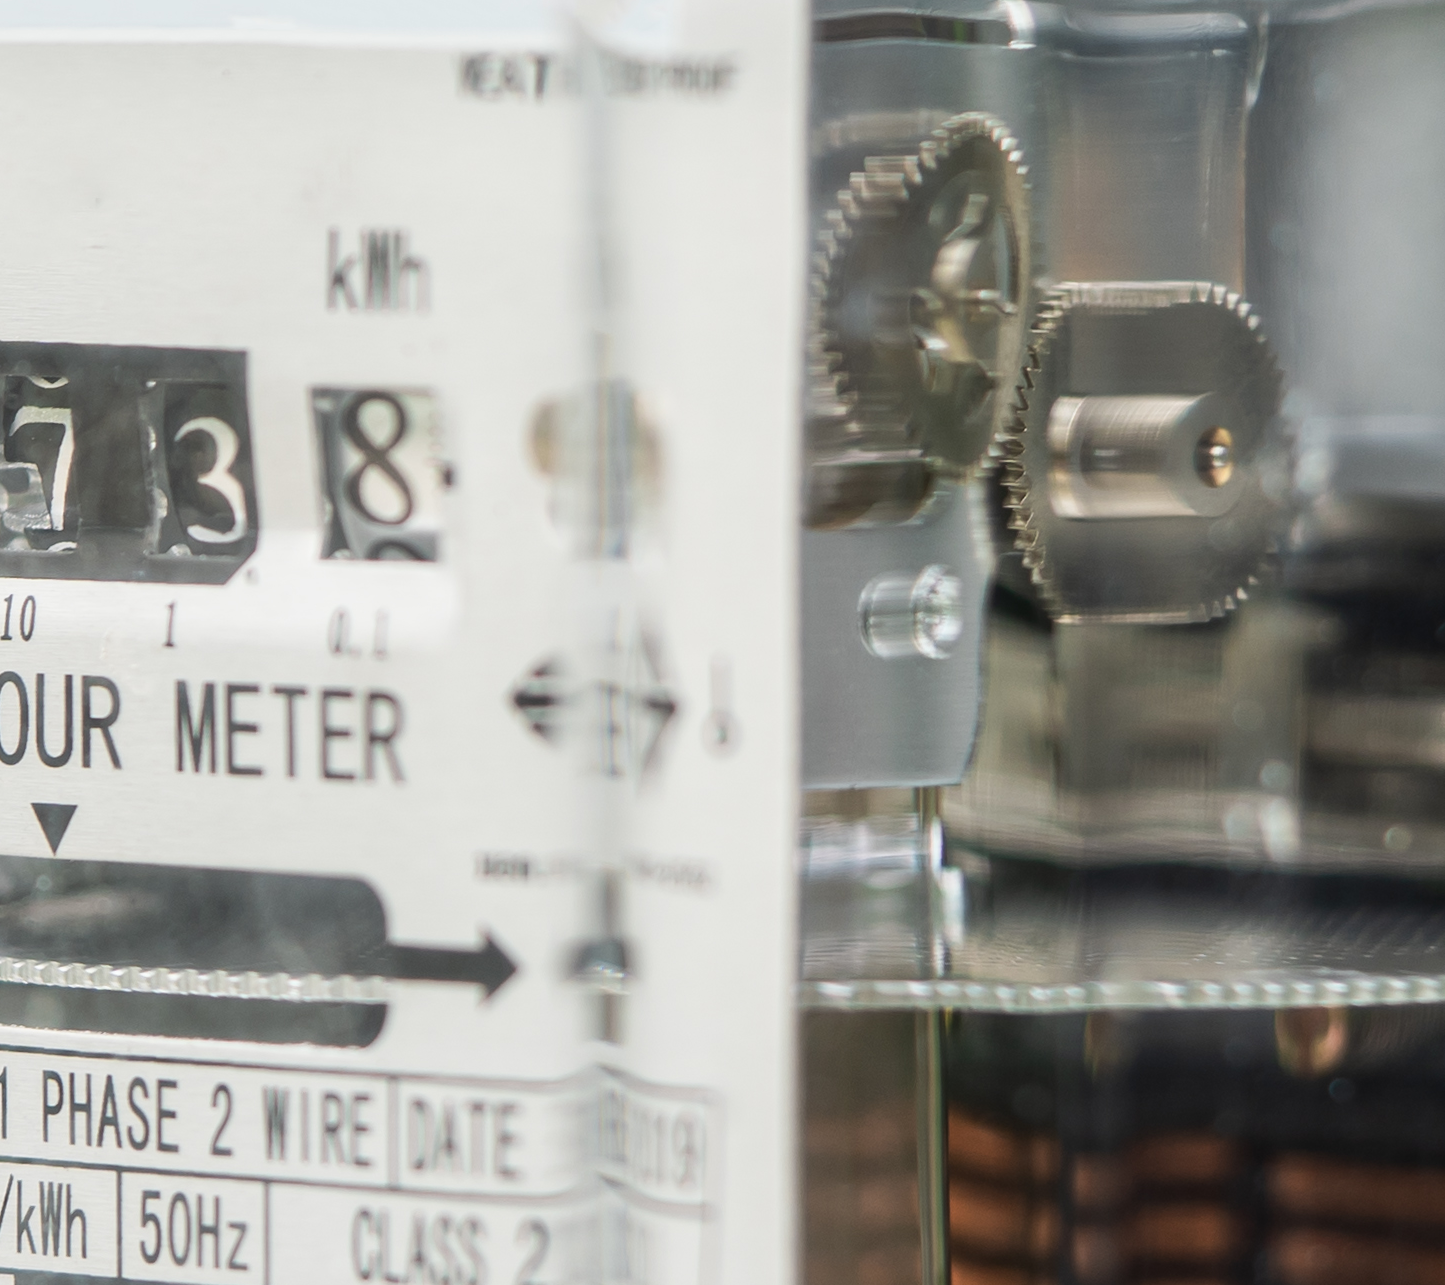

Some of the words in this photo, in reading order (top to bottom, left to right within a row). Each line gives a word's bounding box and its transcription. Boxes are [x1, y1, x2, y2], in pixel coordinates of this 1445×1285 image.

[327, 226, 431, 313] kWh
[0, 594, 36, 642] 10
[163, 600, 176, 648] 1
[327, 606, 390, 660] 0.1
[175, 680, 406, 783] METER
[42, 1070, 179, 1153] PHASE
[211, 1083, 233, 1157] 2
[262, 1086, 374, 1168] WIRE
[408, 1097, 524, 1181] DATE
[140, 1189, 249, 1271] 50Hz
